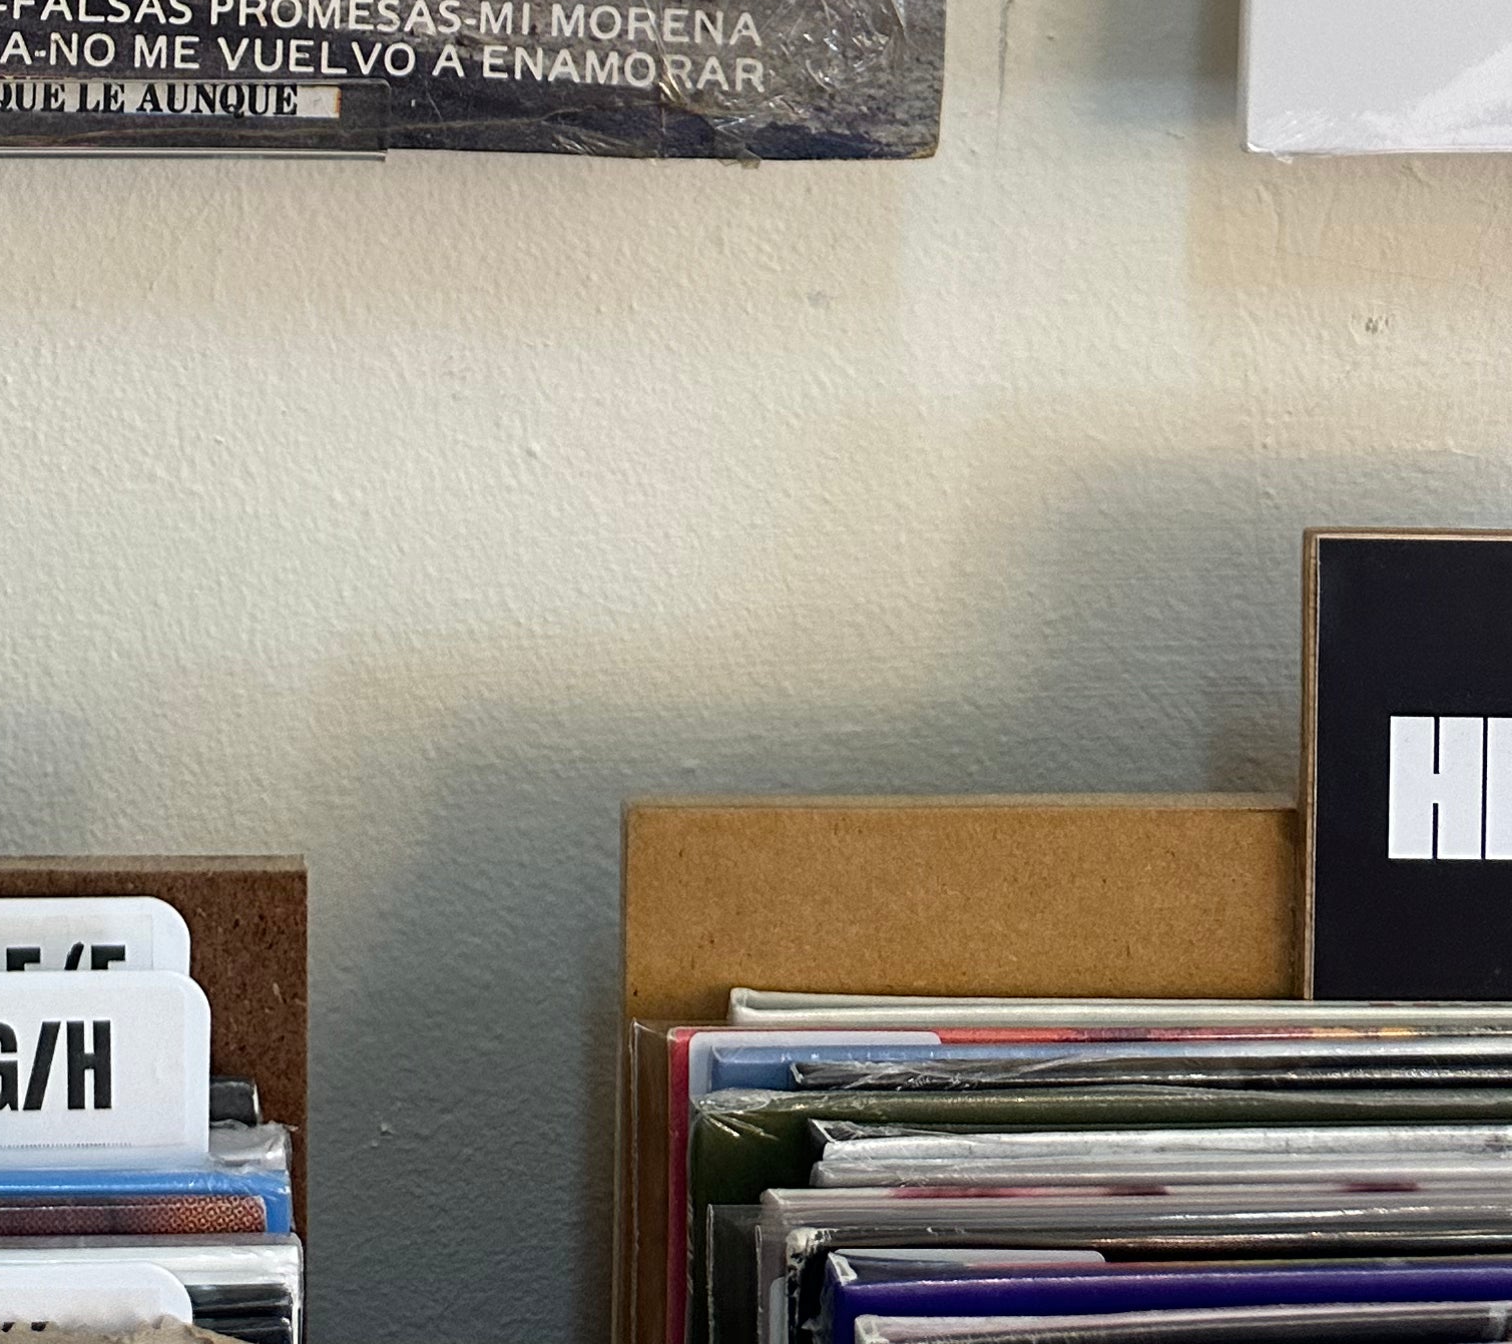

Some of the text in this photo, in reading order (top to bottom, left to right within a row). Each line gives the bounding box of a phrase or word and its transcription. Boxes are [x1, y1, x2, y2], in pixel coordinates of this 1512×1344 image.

[551, 2, 762, 48] MORENA
[134, 34, 200, 70] ME
[217, 36, 416, 78] VUELVO
[432, 48, 465, 78] A
[482, 45, 765, 94] ENAMORAR
[76, 80, 126, 113] LE
[136, 81, 299, 118] AUNQUE
